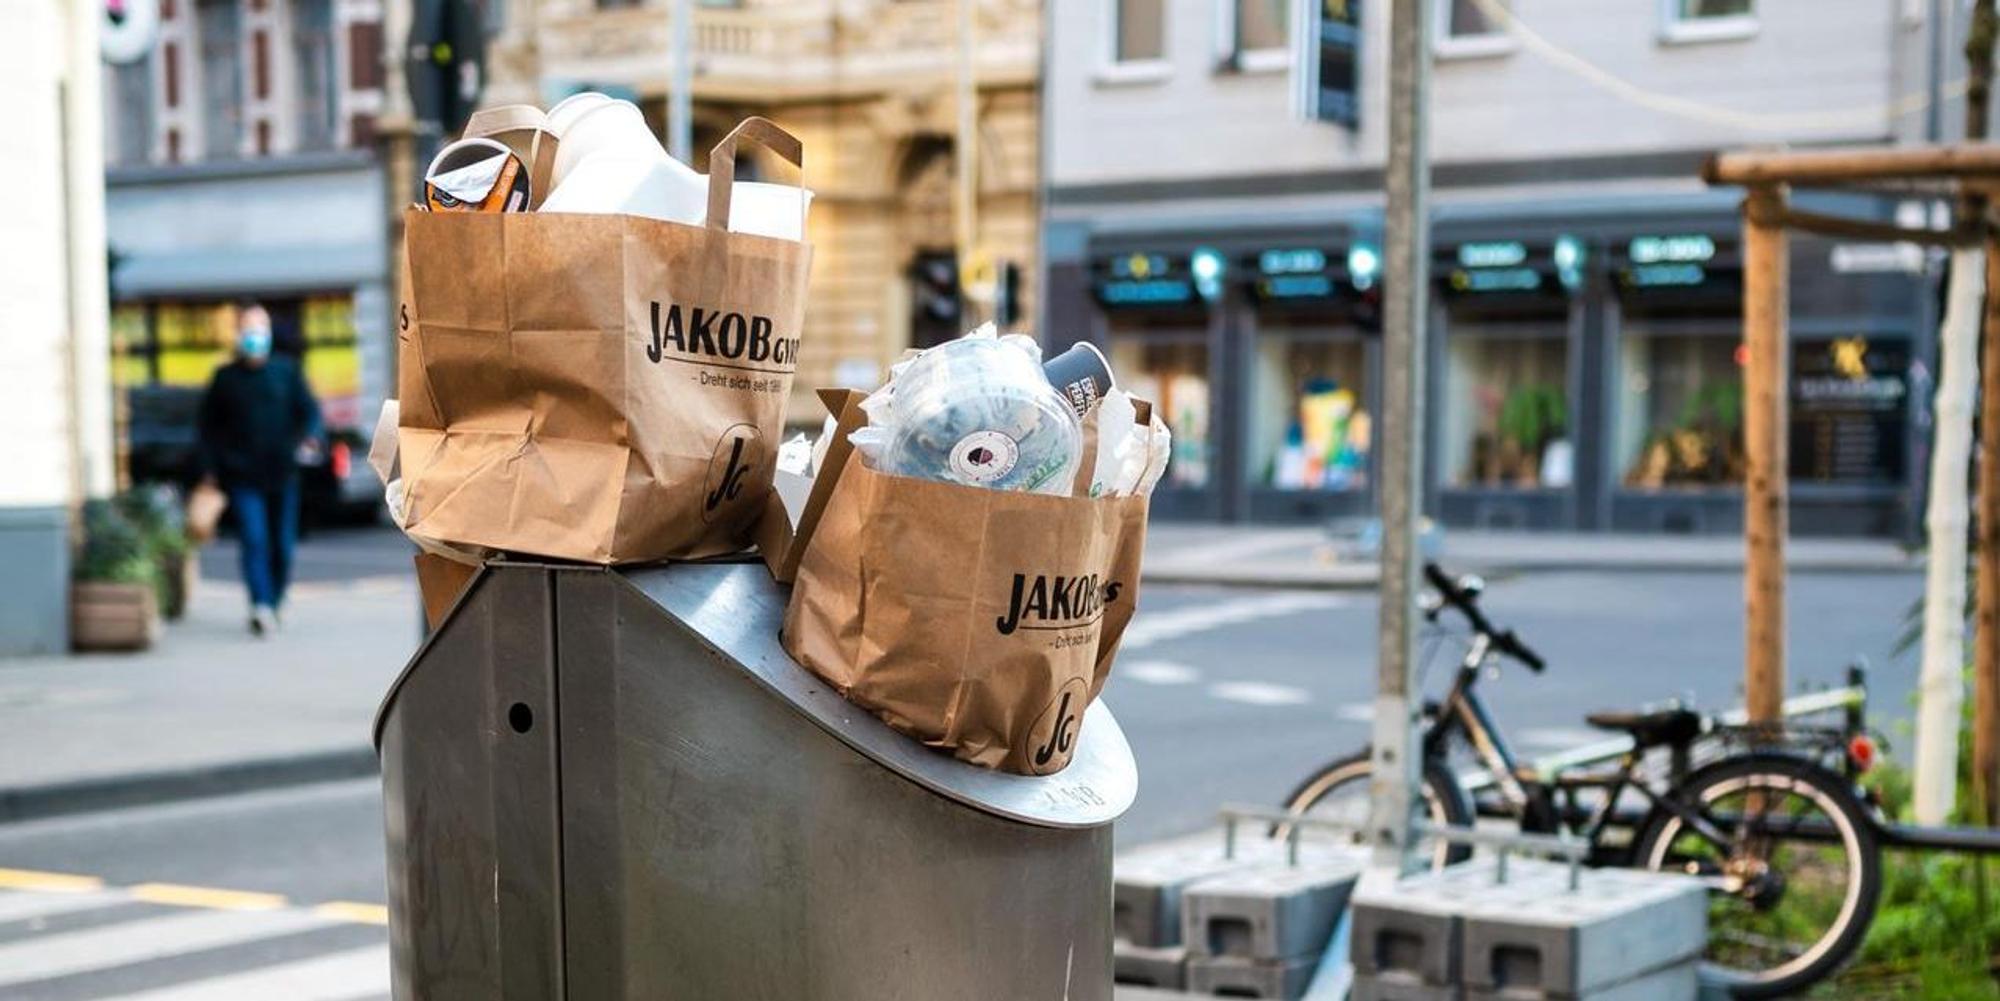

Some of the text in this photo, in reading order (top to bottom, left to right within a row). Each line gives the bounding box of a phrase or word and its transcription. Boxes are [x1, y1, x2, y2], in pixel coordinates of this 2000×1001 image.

[647, 301, 772, 363] JAKOB
[700, 371, 728, 388] Dreht
[729, 374, 750, 391] sich
[996, 573, 1098, 635] JAKOB
